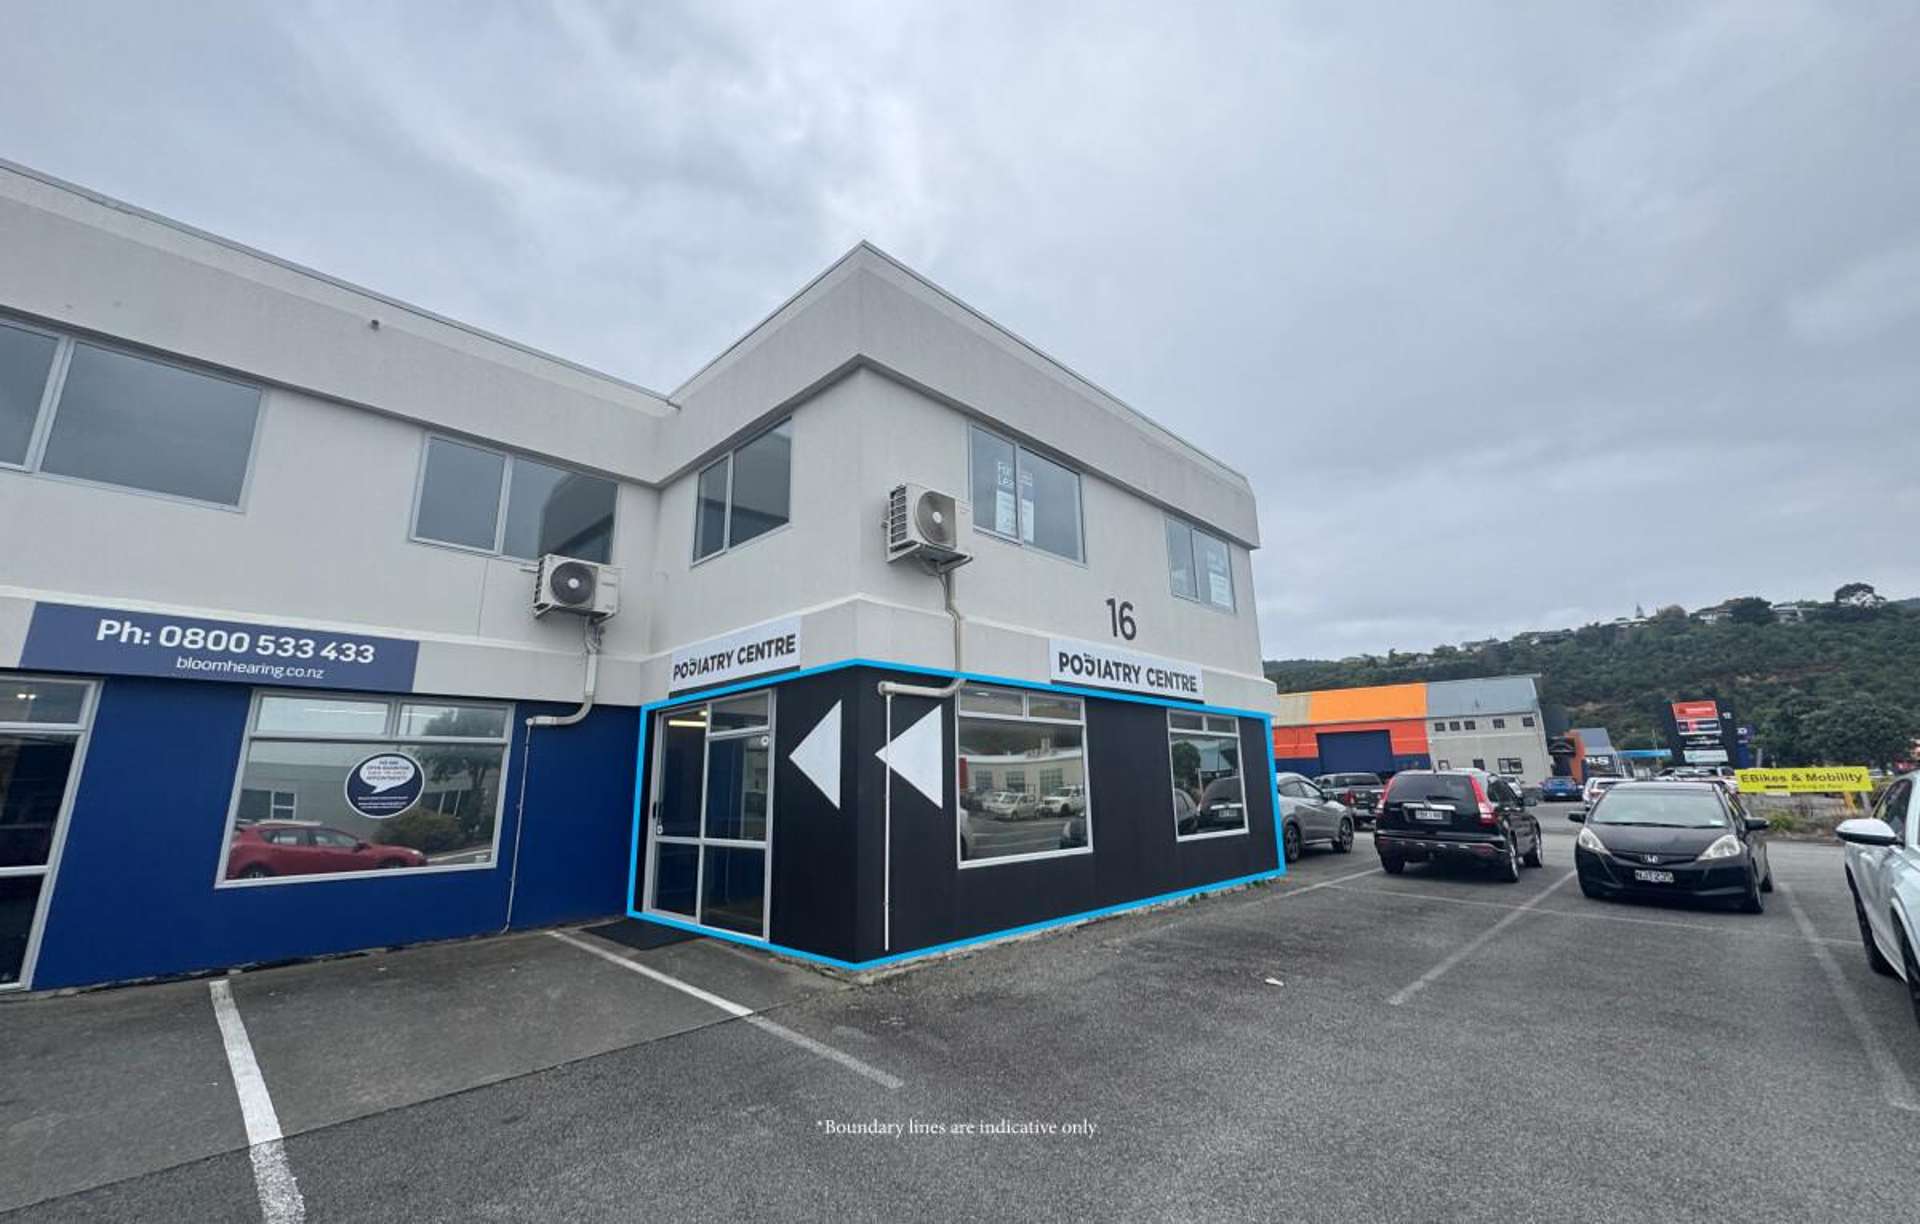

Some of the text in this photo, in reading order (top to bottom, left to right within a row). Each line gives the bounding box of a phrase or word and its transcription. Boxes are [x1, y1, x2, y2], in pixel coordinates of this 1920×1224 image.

[1105, 598, 1137, 641] 16
[96, 619, 375, 664] Ph: 0800 533 433
[673, 634, 796, 681] PODIATRY CENTRE
[176, 656, 325, 680] bloomhearing.co.nz
[1058, 652, 1198, 693] PODIATRY CENTRE
[1740, 771, 1862, 783] EBikes & Mobility
